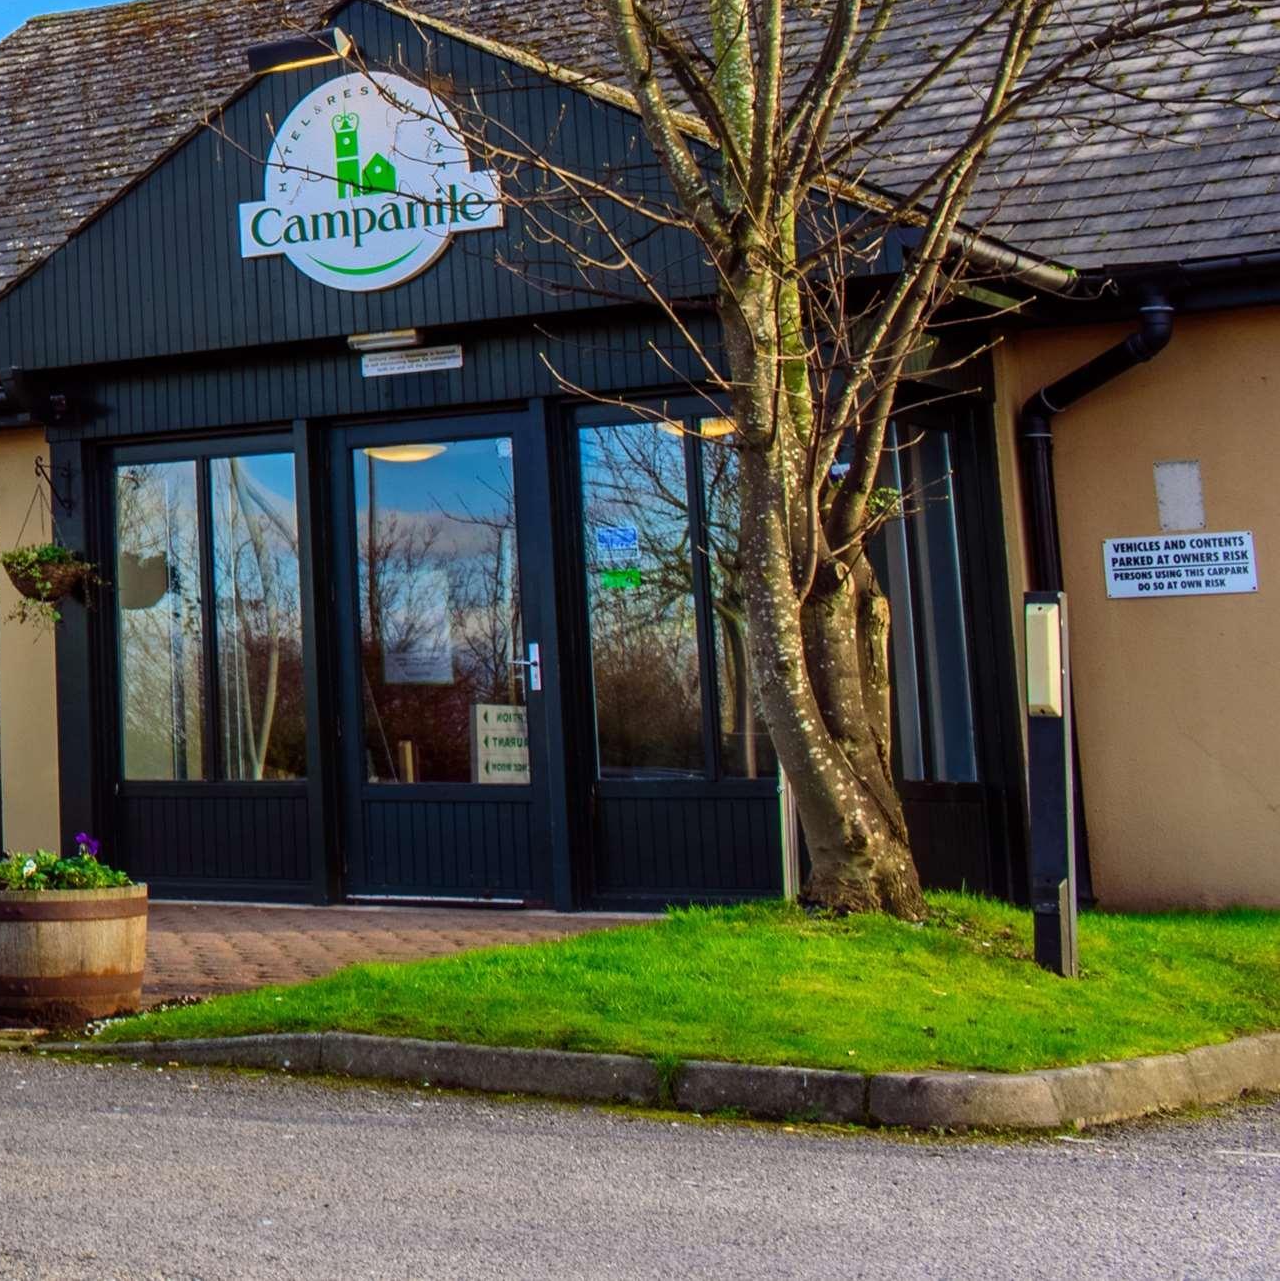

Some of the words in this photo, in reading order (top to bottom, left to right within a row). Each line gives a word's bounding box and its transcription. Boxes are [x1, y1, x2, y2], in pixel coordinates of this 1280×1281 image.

[250, 184, 484, 248] Campanile
[1112, 540, 1161, 554] VEHICLES
[1163, 539, 1186, 551] AND
[1189, 536, 1245, 549] CONTENTS
[1111, 555, 1154, 568] PARKED
[1157, 554, 1170, 566] AT
[1173, 551, 1220, 564] OWNERS
[1222, 550, 1249, 562] RISK
[1113, 570, 1153, 581] PERSONS
[1154, 569, 1183, 579] USING
[1185, 567, 1205, 578] THIS
[1207, 565, 1249, 577] CARPARK
[1138, 582, 1151, 591] DO
[1153, 581, 1165, 591] SO
[1167, 580, 1178, 590] AT
[1180, 579, 1202, 589] OWN
[1205, 578, 1226, 589] RISK
